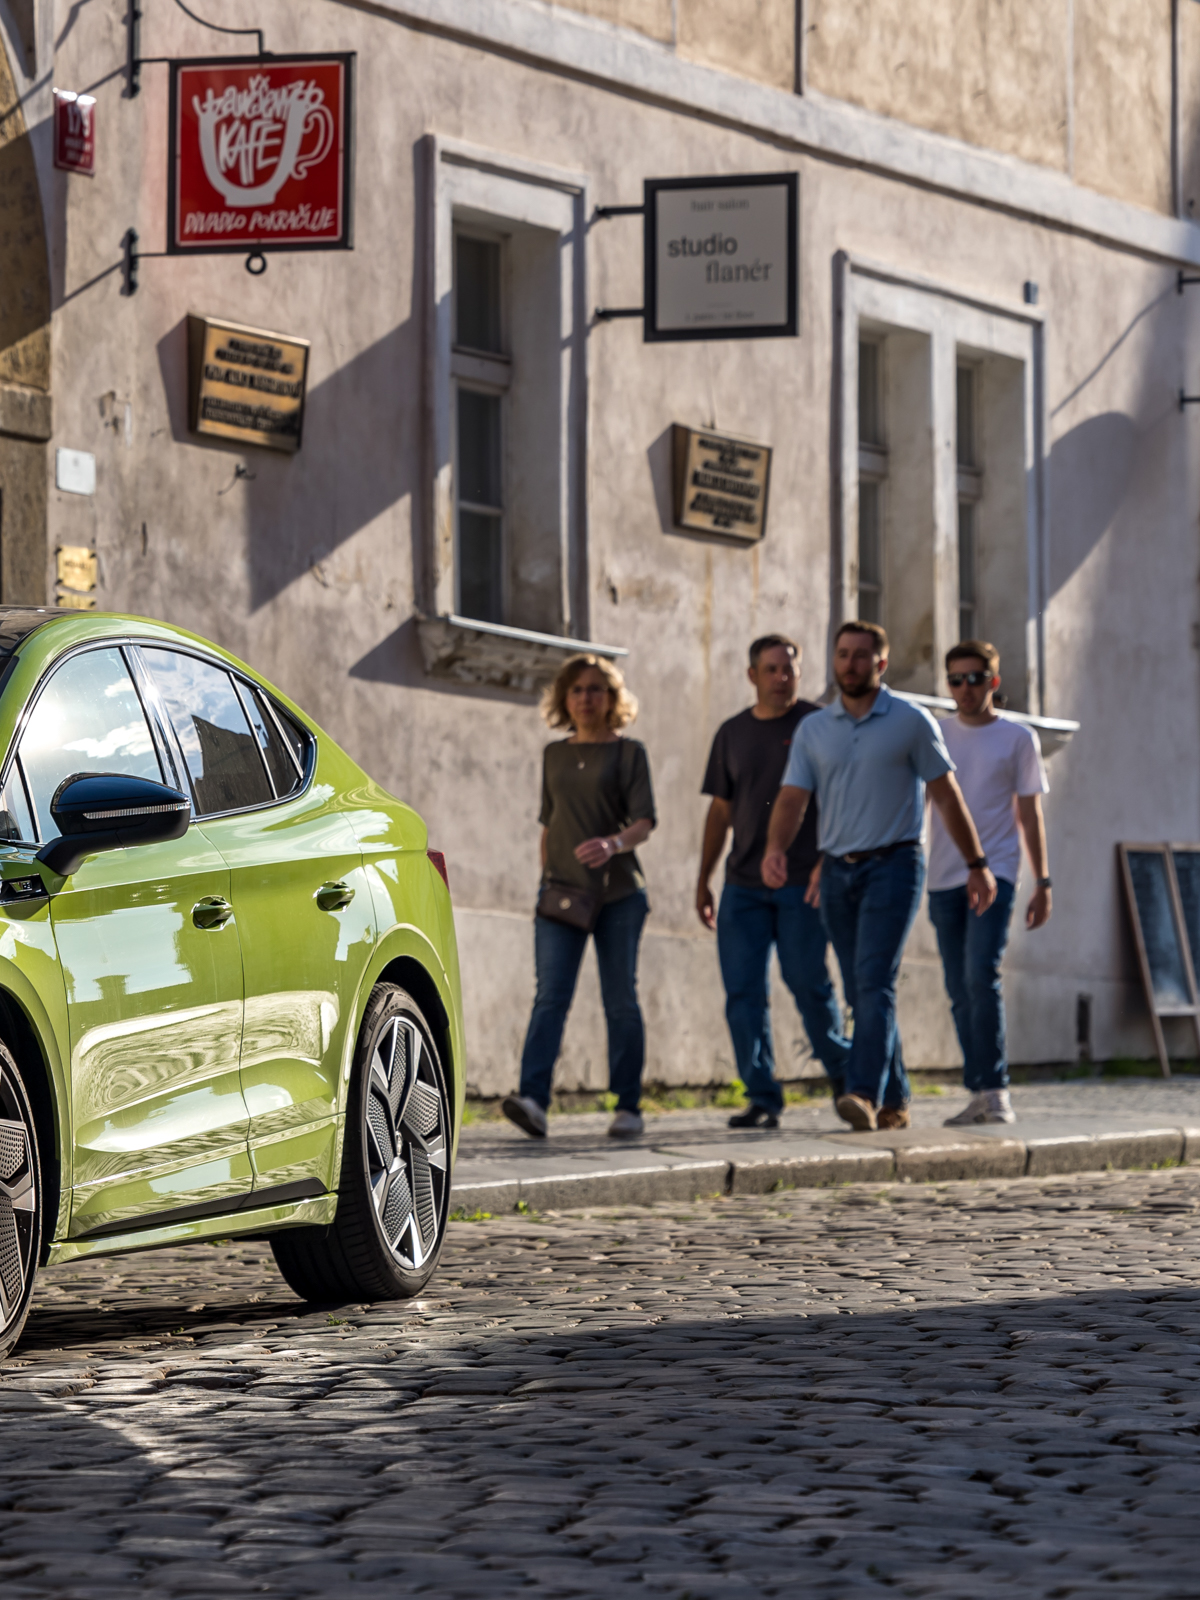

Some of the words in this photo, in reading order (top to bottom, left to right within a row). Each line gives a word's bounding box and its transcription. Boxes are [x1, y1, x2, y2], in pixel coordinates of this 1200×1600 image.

[184, 210, 248, 235] DIVADLO
[667, 232, 738, 257] studio
[705, 258, 773, 284] flanér
